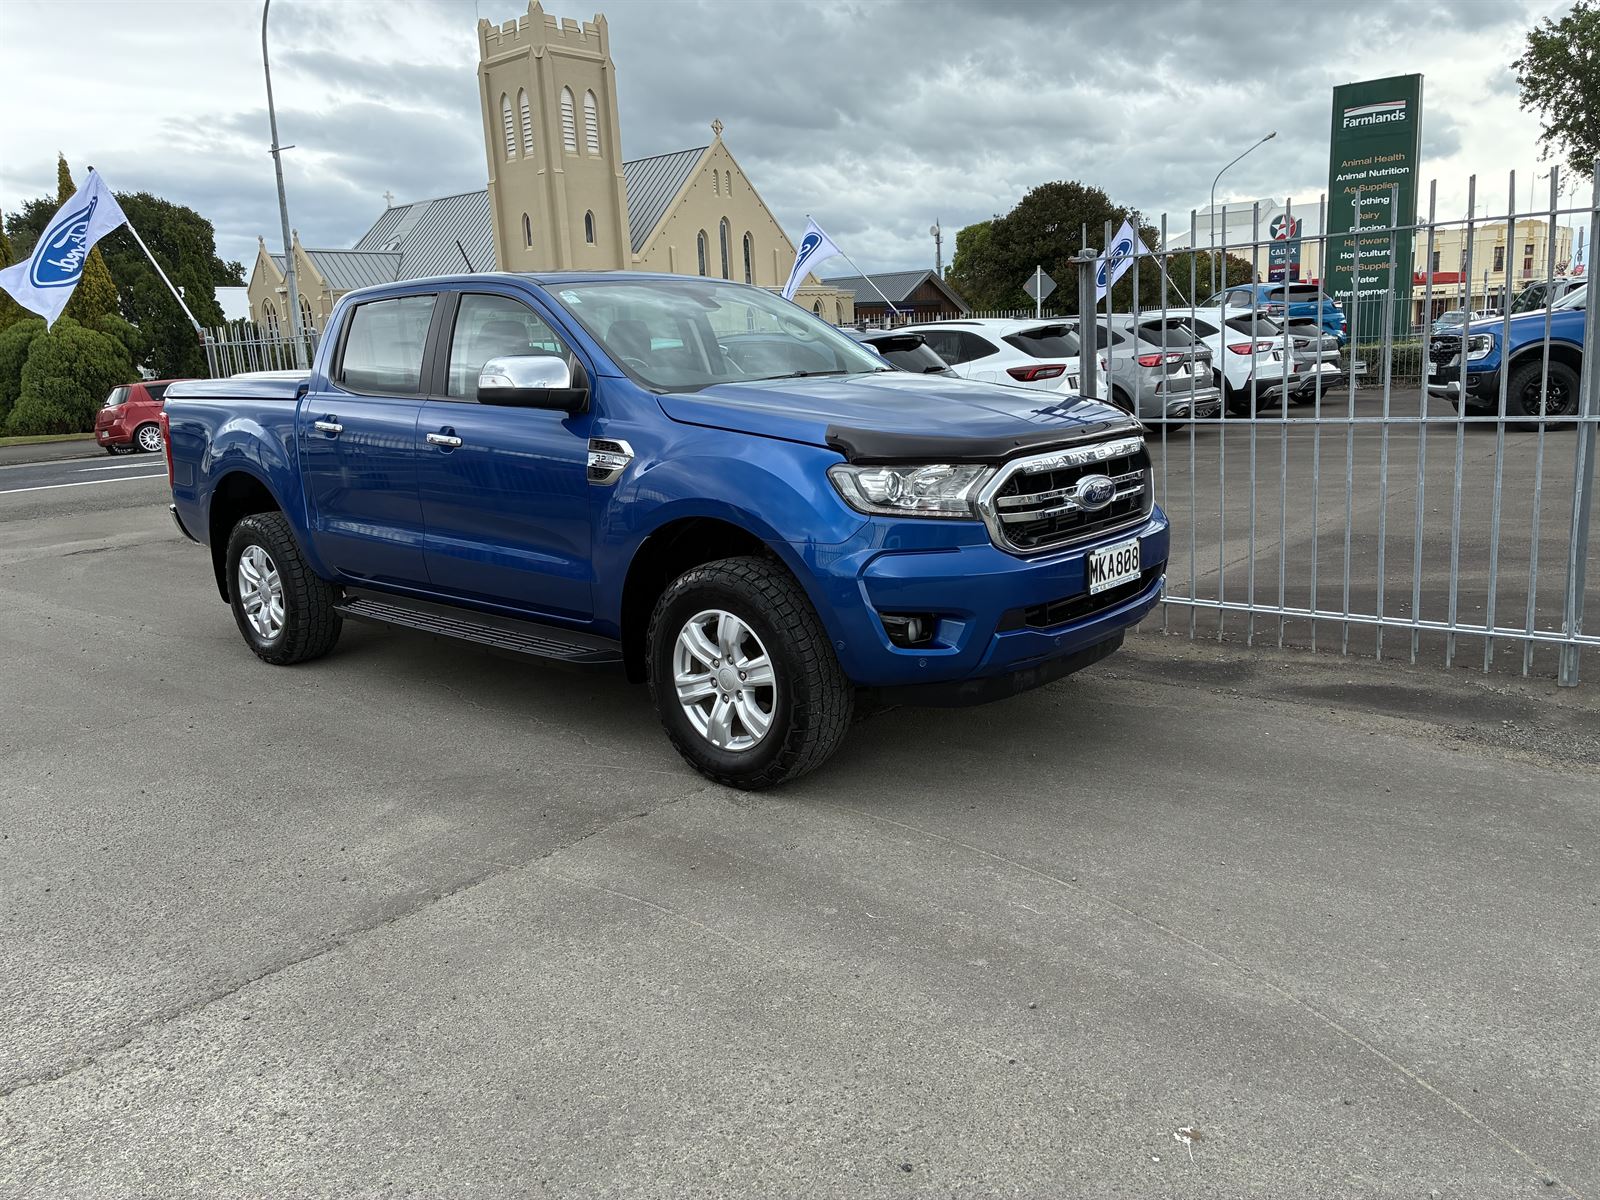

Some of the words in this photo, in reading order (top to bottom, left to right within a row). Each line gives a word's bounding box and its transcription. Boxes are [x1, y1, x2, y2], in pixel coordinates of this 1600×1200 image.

[1343, 109, 1406, 128] Farmlands
[1341, 157, 1372, 168] Animal
[1374, 153, 1405, 163] Health
[1336, 170, 1367, 181] Animal
[1369, 166, 1409, 177] Nutrition
[1344, 186, 1357, 194] Ag
[1351, 197, 1390, 207] Cothing
[1357, 211, 1380, 220] airy
[1344, 237, 1390, 247] Hadware
[1270, 247, 1297, 256] CALTX
[1090, 484, 1111, 500] Ford
[1090, 547, 1139, 586] MKA808
